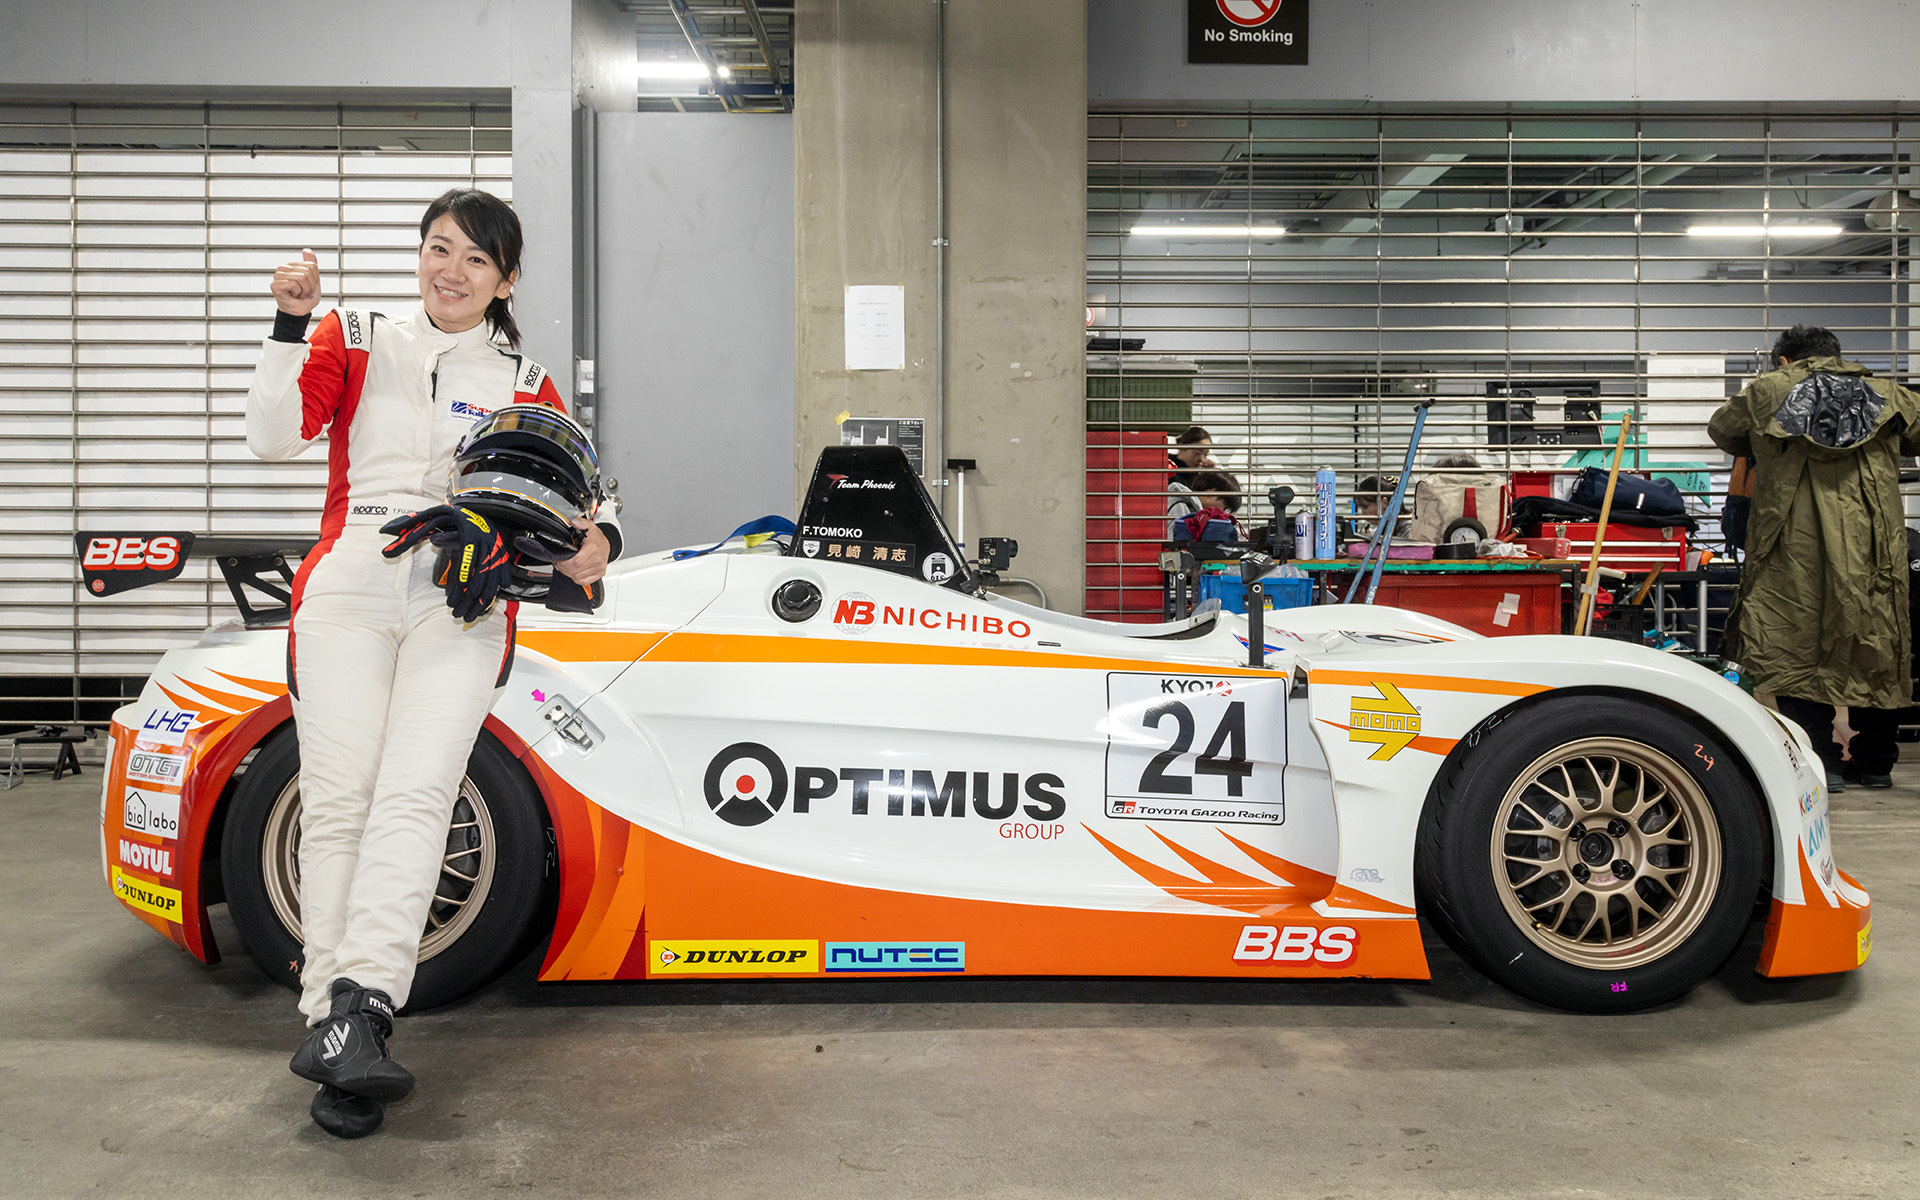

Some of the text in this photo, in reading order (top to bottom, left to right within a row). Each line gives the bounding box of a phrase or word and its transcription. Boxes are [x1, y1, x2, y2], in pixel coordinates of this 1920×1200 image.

[1204, 28, 1294, 46] No Smoking
[345, 310, 362, 345] sparco
[837, 479, 896, 490] Team Phoenix
[351, 506, 388, 515] sparco
[802, 525, 863, 538] F.TOMOKO
[83, 536, 180, 571] BBS
[827, 544, 907, 561] 見崎 清志
[833, 600, 1031, 638] NB NICHIBO
[143, 709, 195, 733] LHG
[1350, 712, 1421, 731] momo
[1138, 700, 1254, 797] 24
[1694, 743, 1715, 771] 24
[704, 742, 1066, 827] OPTIMUS
[128, 805, 177, 831] bio labo
[1112, 801, 1279, 821] GR TOYOTA GAZOO Racing
[999, 822, 1065, 840] GROUP
[120, 839, 172, 876] MOTUL
[122, 883, 175, 911] DUNLOP
[683, 950, 807, 964] DUNLOP
[1232, 925, 1360, 969] BBS
[1610, 981, 1628, 992] FR
